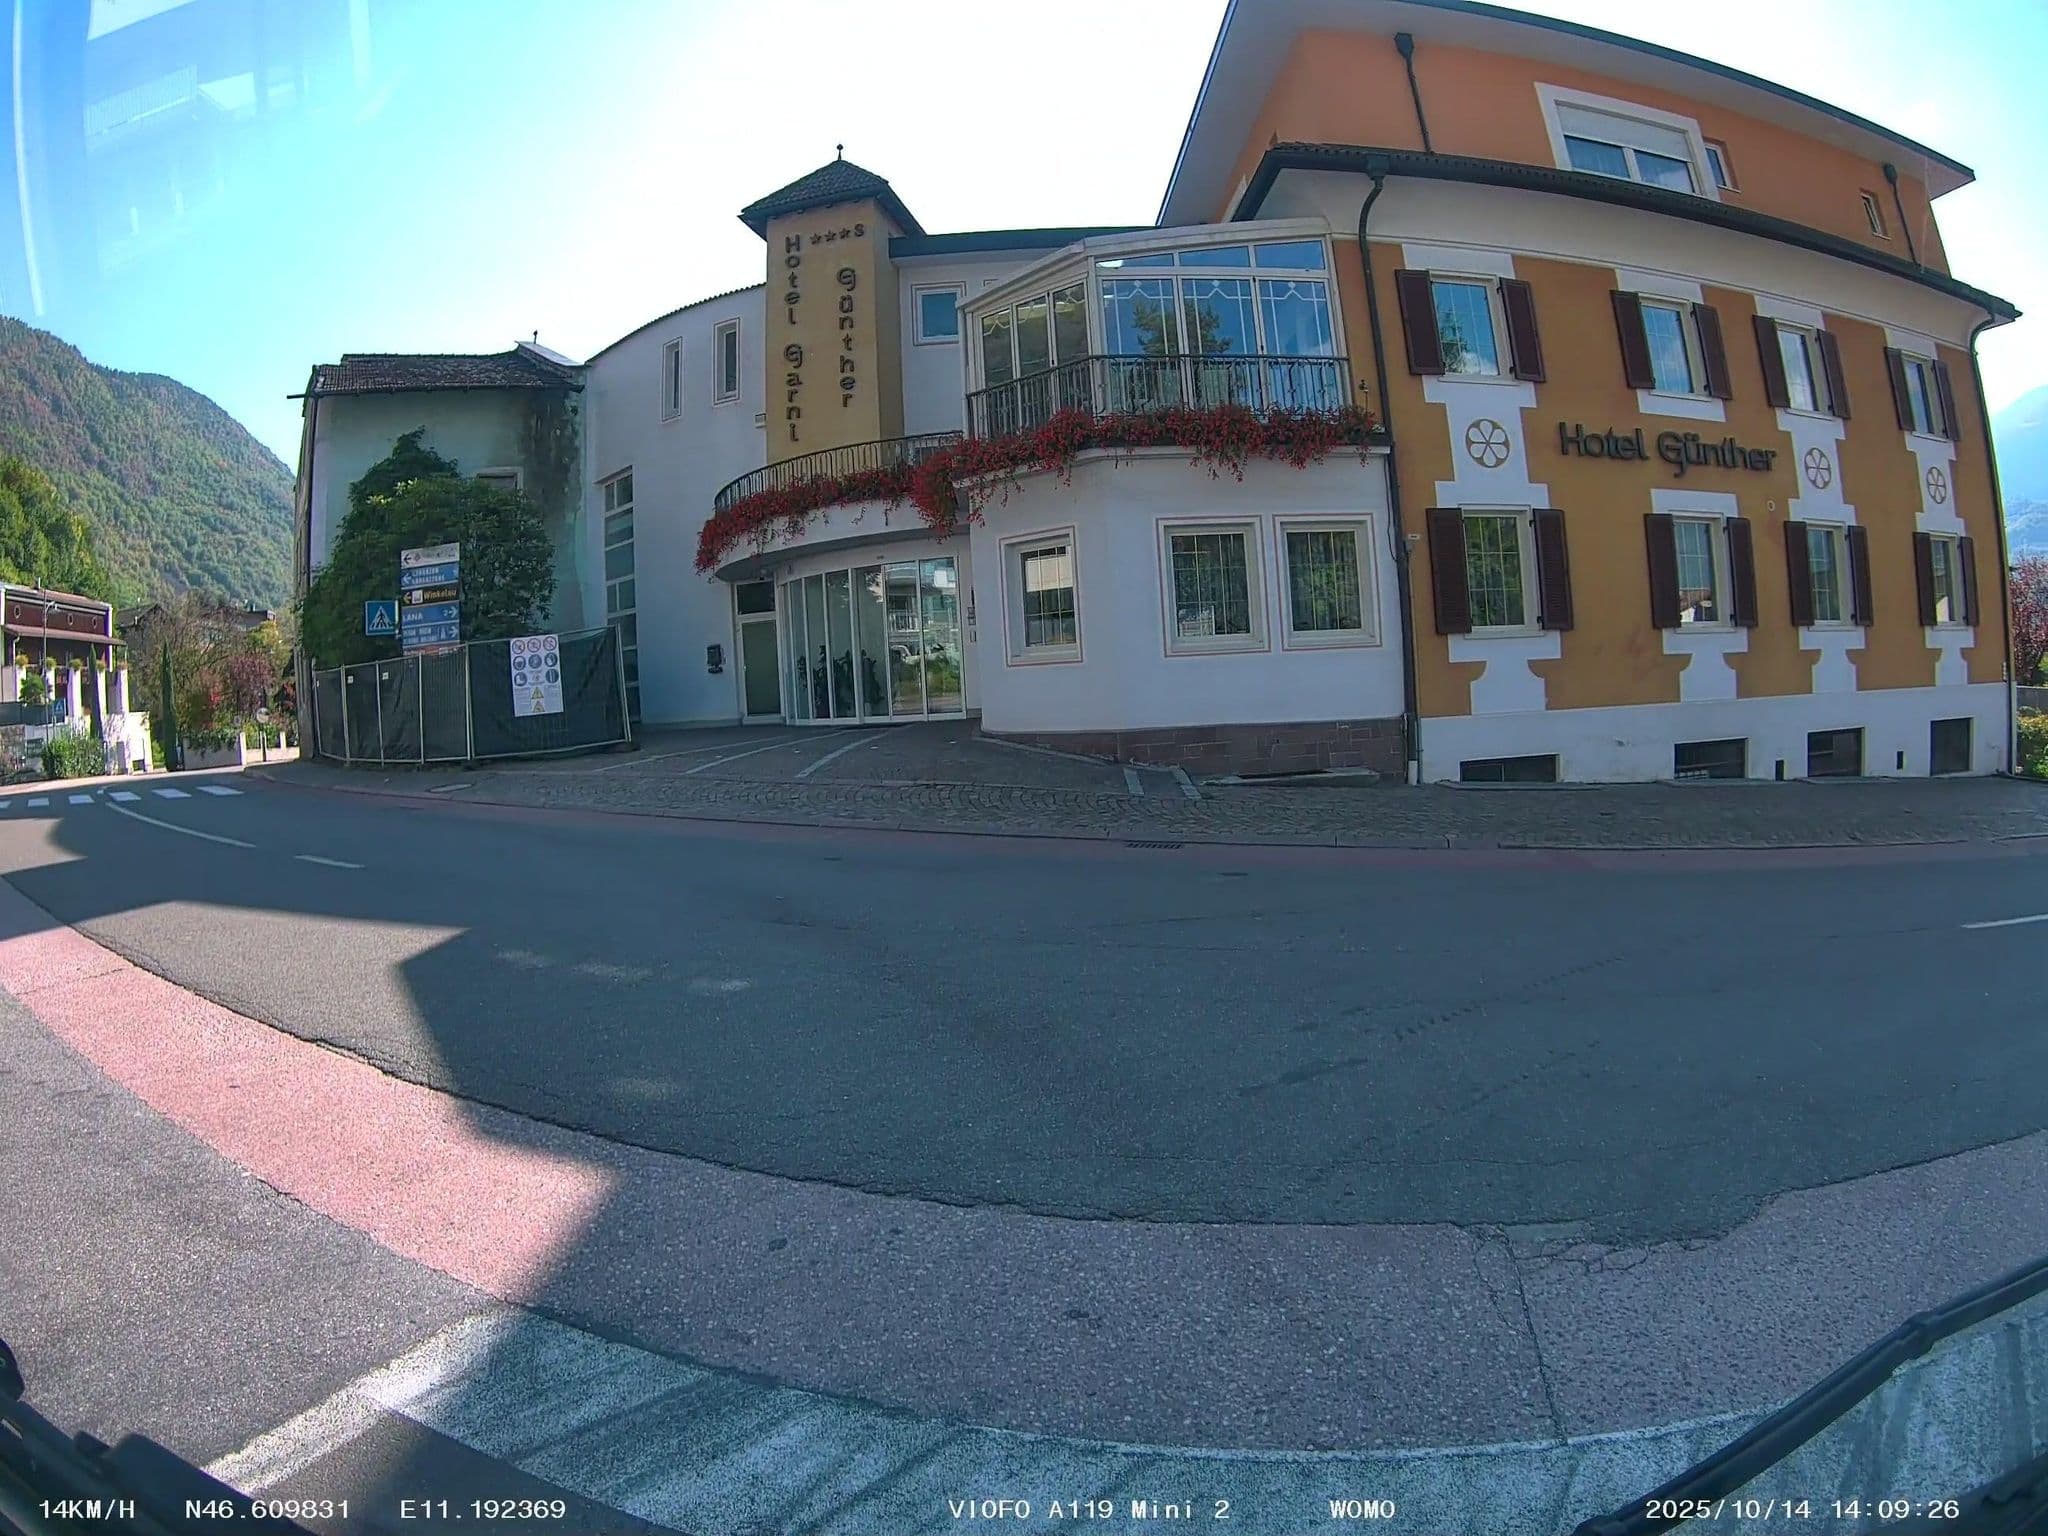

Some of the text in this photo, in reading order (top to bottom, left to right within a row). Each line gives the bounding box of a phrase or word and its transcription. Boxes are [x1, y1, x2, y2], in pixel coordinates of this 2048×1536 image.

[783, 233, 804, 443] Hotel Garni
[836, 267, 857, 408] Günther
[1558, 421, 1778, 479] Hotel Günther
